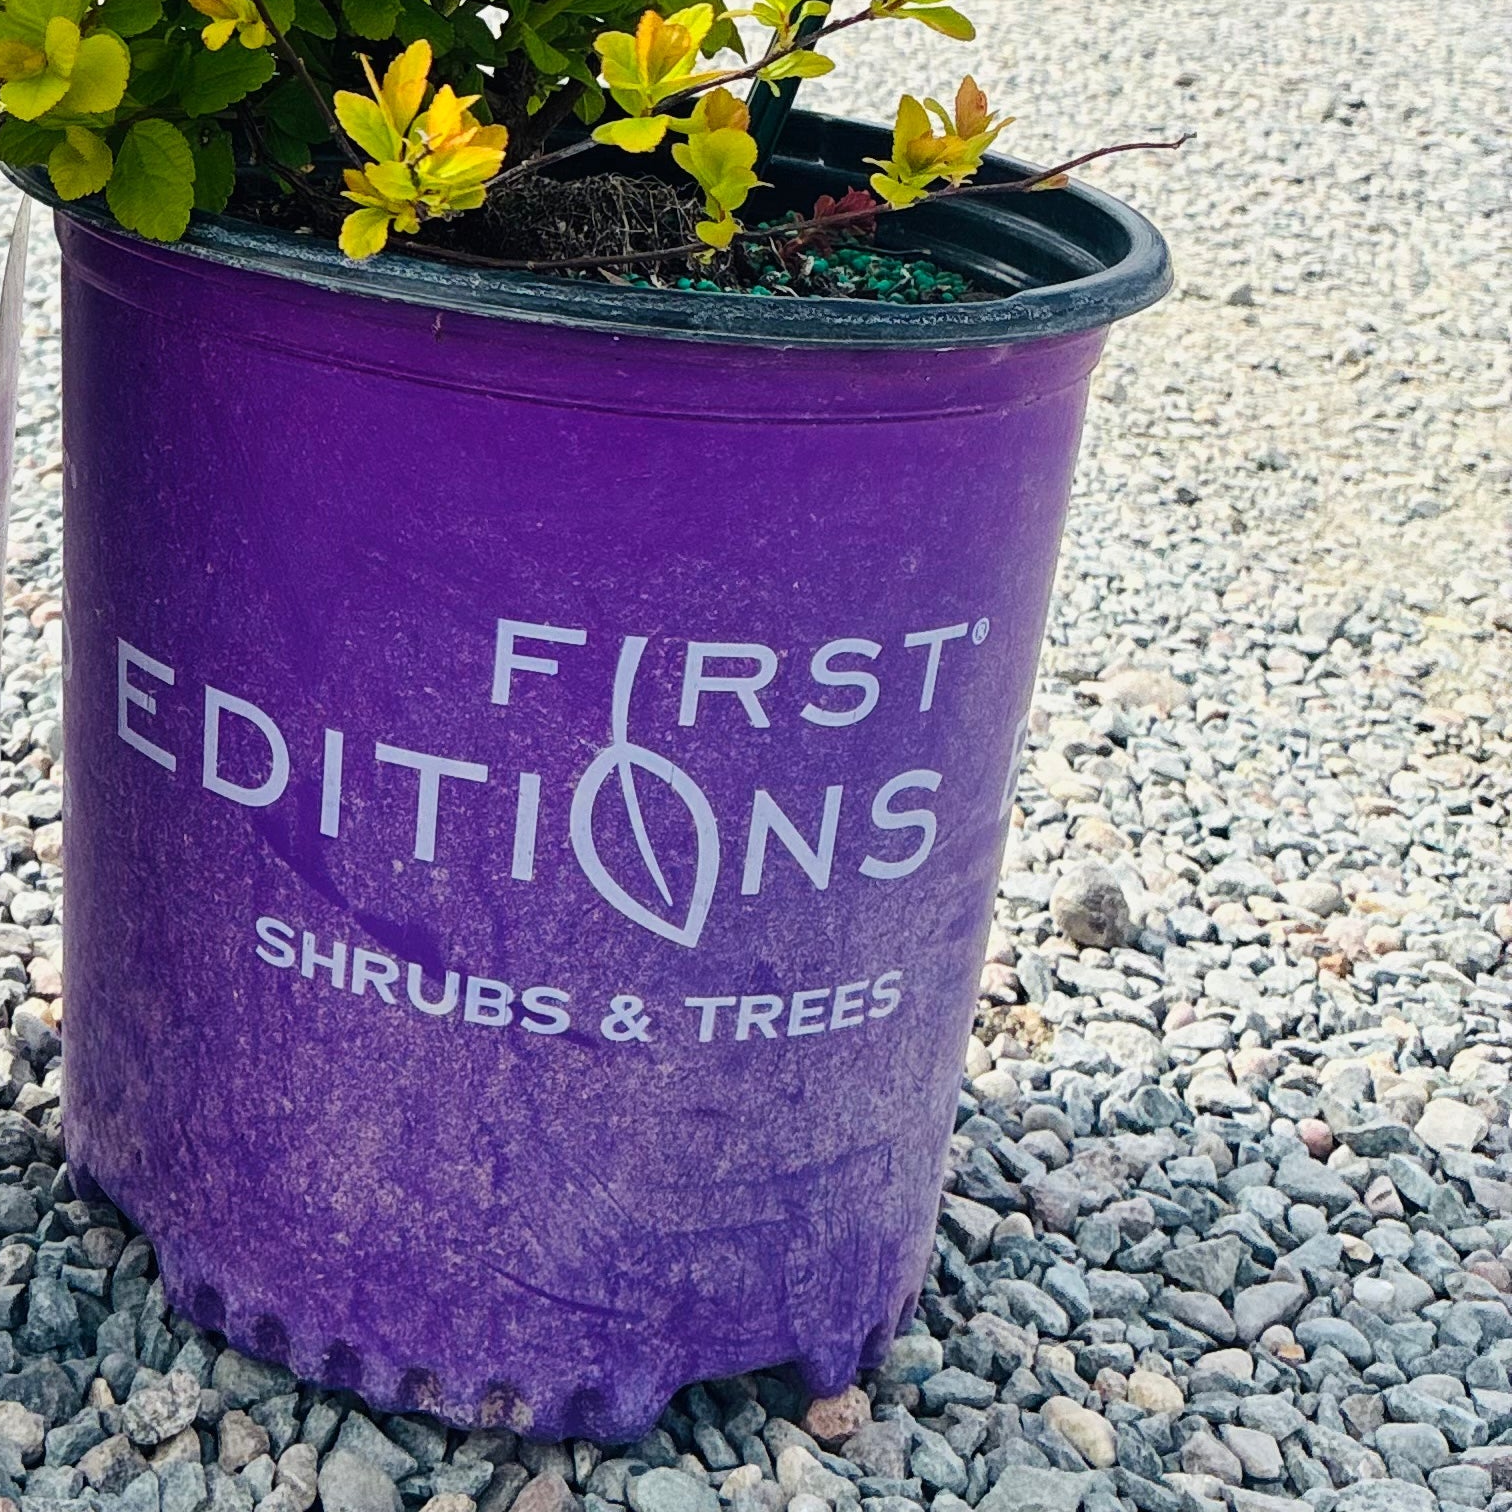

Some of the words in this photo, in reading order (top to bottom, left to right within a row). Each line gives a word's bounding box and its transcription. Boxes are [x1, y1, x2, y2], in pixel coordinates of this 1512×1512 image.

[117, 636, 943, 948] EDITIONS
[255, 916, 572, 1036] SHRUBS
[599, 995, 654, 1044] &
[685, 970, 904, 1043] TREES
